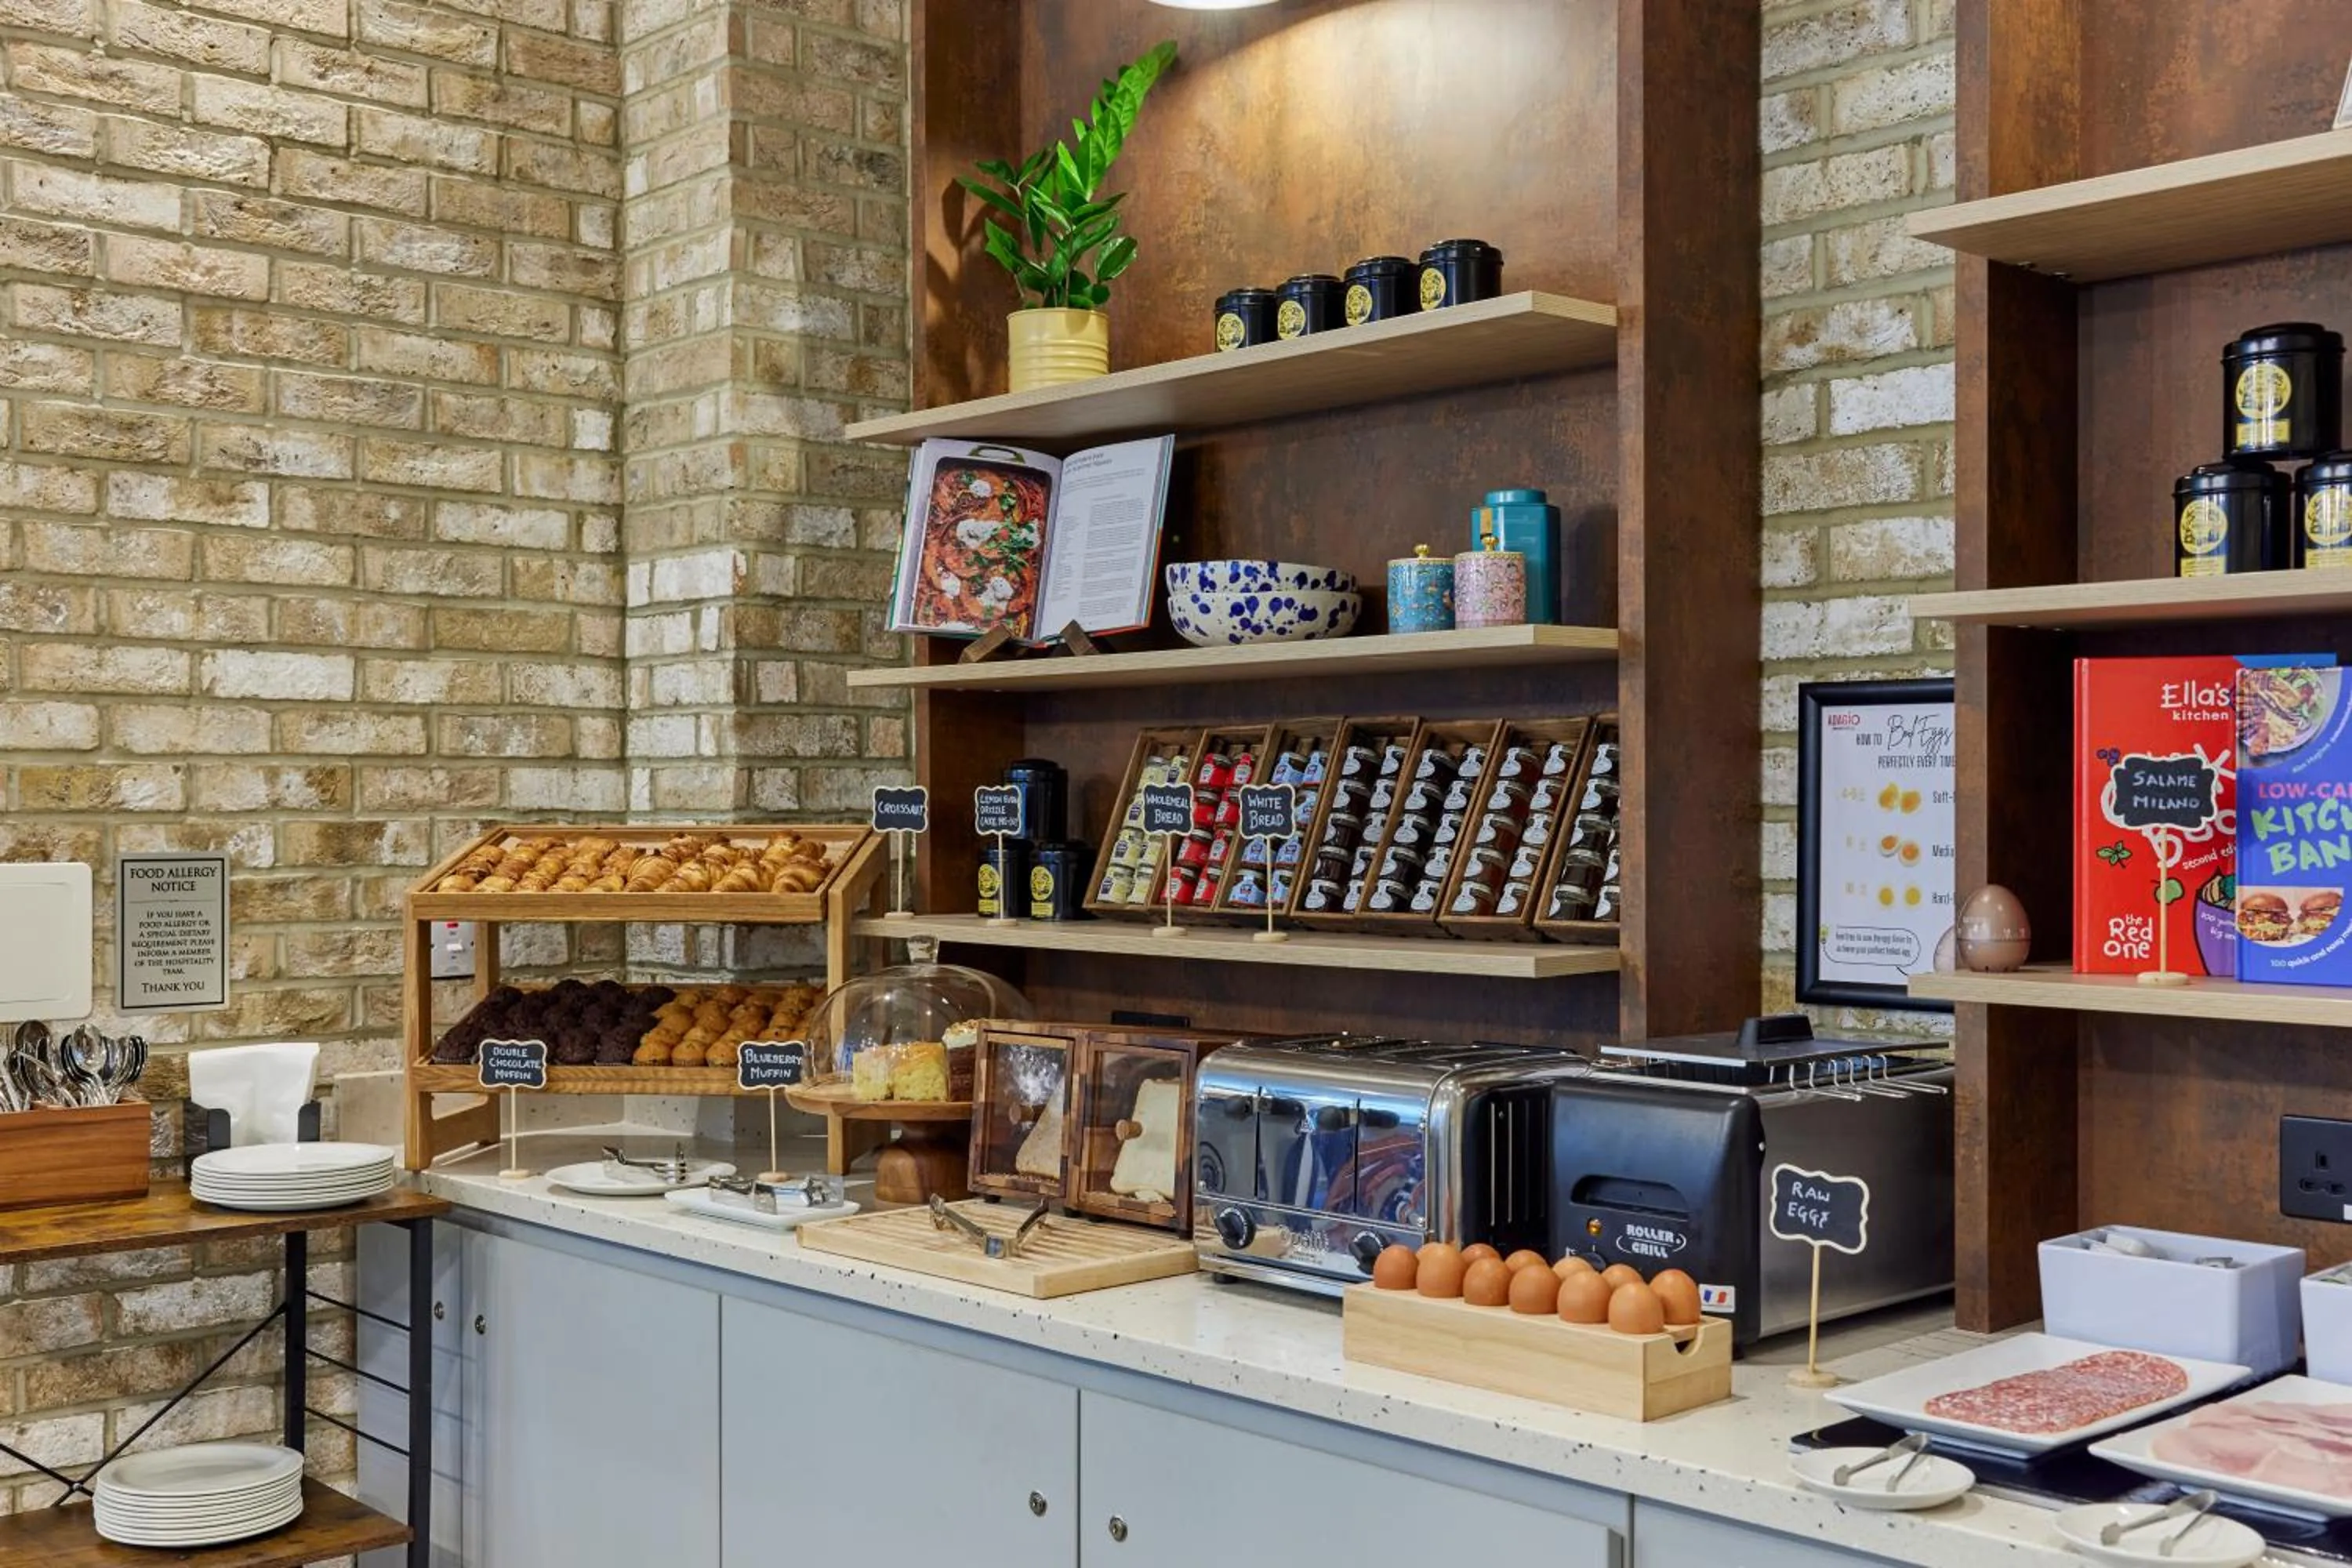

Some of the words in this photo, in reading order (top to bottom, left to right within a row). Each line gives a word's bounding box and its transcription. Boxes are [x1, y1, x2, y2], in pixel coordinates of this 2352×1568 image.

[2161, 680, 2230, 709] Ella's
[2172, 710, 2230, 721] kitchen
[2132, 771, 2198, 789] SALAME
[1933, 790, 1955, 804] Soft-
[2259, 782, 2352, 799] LOW-CA
[1247, 794, 1283, 809] WHITE
[2132, 795, 2201, 810] MILANO
[1154, 808, 1183, 824] BREAD
[1249, 810, 1284, 829] BREAD
[2182, 848, 2218, 870] second
[130, 868, 165, 878] FOOD
[167, 866, 217, 878] ALLERGY
[151, 880, 196, 891] NOTICE
[2108, 916, 2154, 942] Red
[141, 982, 180, 993] THANK
[183, 981, 205, 991] YOU
[488, 1058, 541, 1069] CHOCOLATE
[744, 1047, 802, 1065] BLUEBERRY
[495, 1069, 532, 1080] MUFFIN
[750, 1066, 791, 1080] MUFFIN
[1791, 1181, 1831, 1202] RAW
[1626, 1224, 1675, 1243] ROLLER
[1631, 1240, 1669, 1259] GRILL
